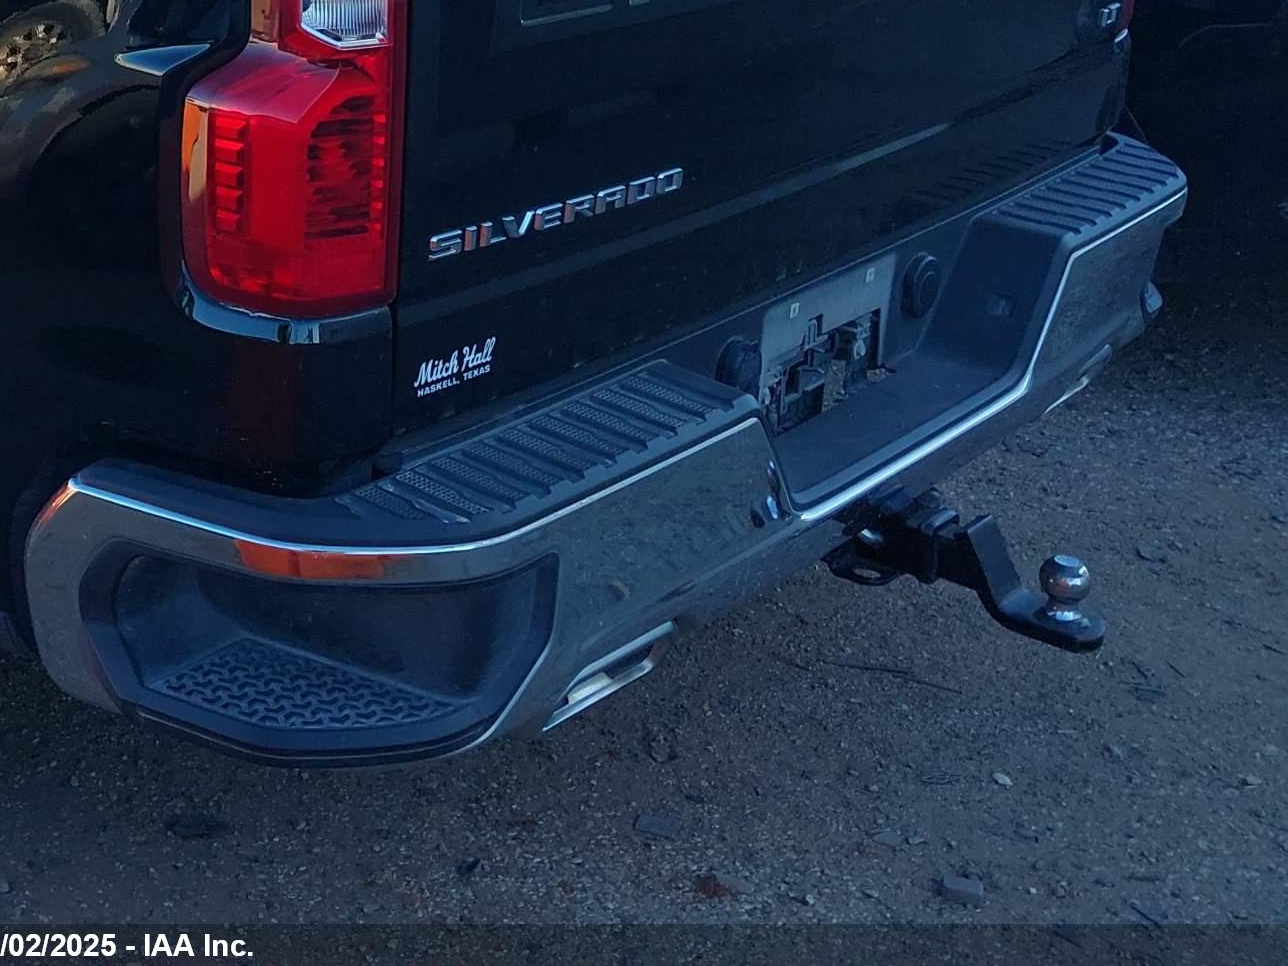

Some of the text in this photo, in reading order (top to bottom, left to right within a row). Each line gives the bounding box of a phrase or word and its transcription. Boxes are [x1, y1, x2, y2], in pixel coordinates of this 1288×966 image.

[1097, 2, 1121, 27] LT
[427, 167, 684, 262] SILVERADO
[414, 336, 496, 388] Mitch Hall
[463, 364, 491, 381] TEXAS
